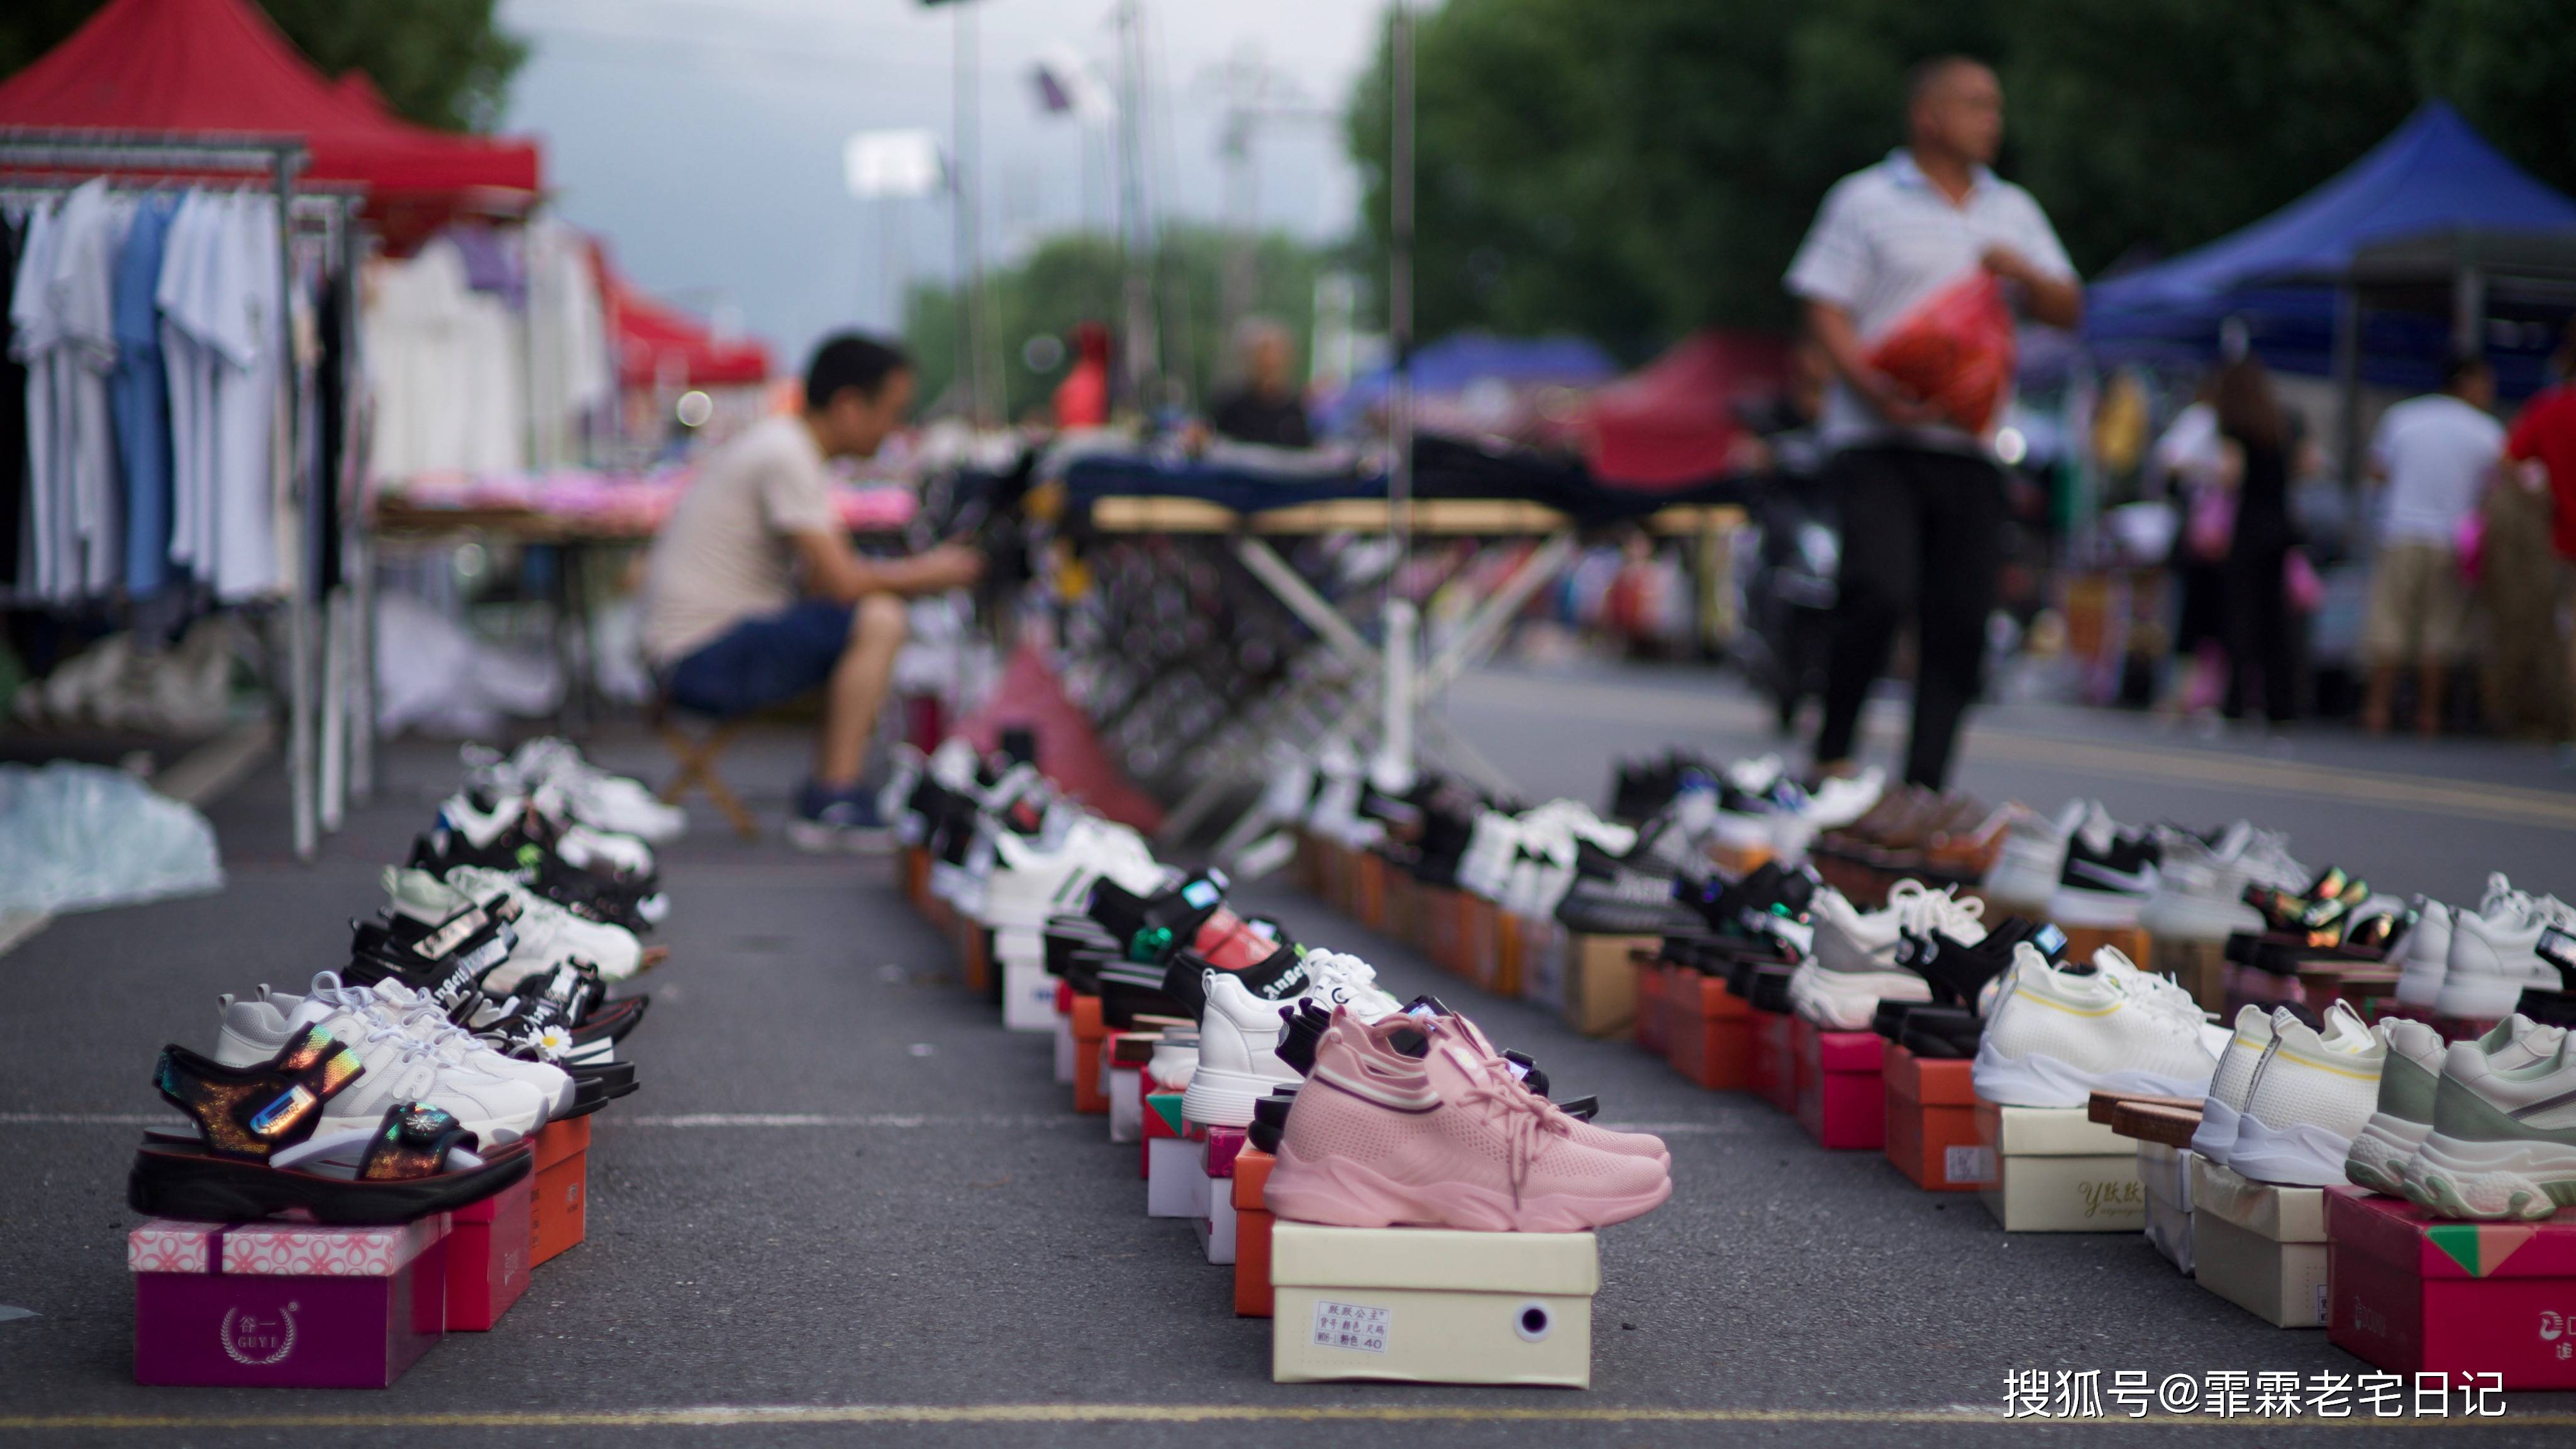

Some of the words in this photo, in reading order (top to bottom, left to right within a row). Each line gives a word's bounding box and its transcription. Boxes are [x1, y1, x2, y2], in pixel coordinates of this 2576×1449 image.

[239, 1316, 275, 1333] 谷一
[238, 1337, 277, 1348] GUYI
[1363, 1338, 1382, 1349] 40
